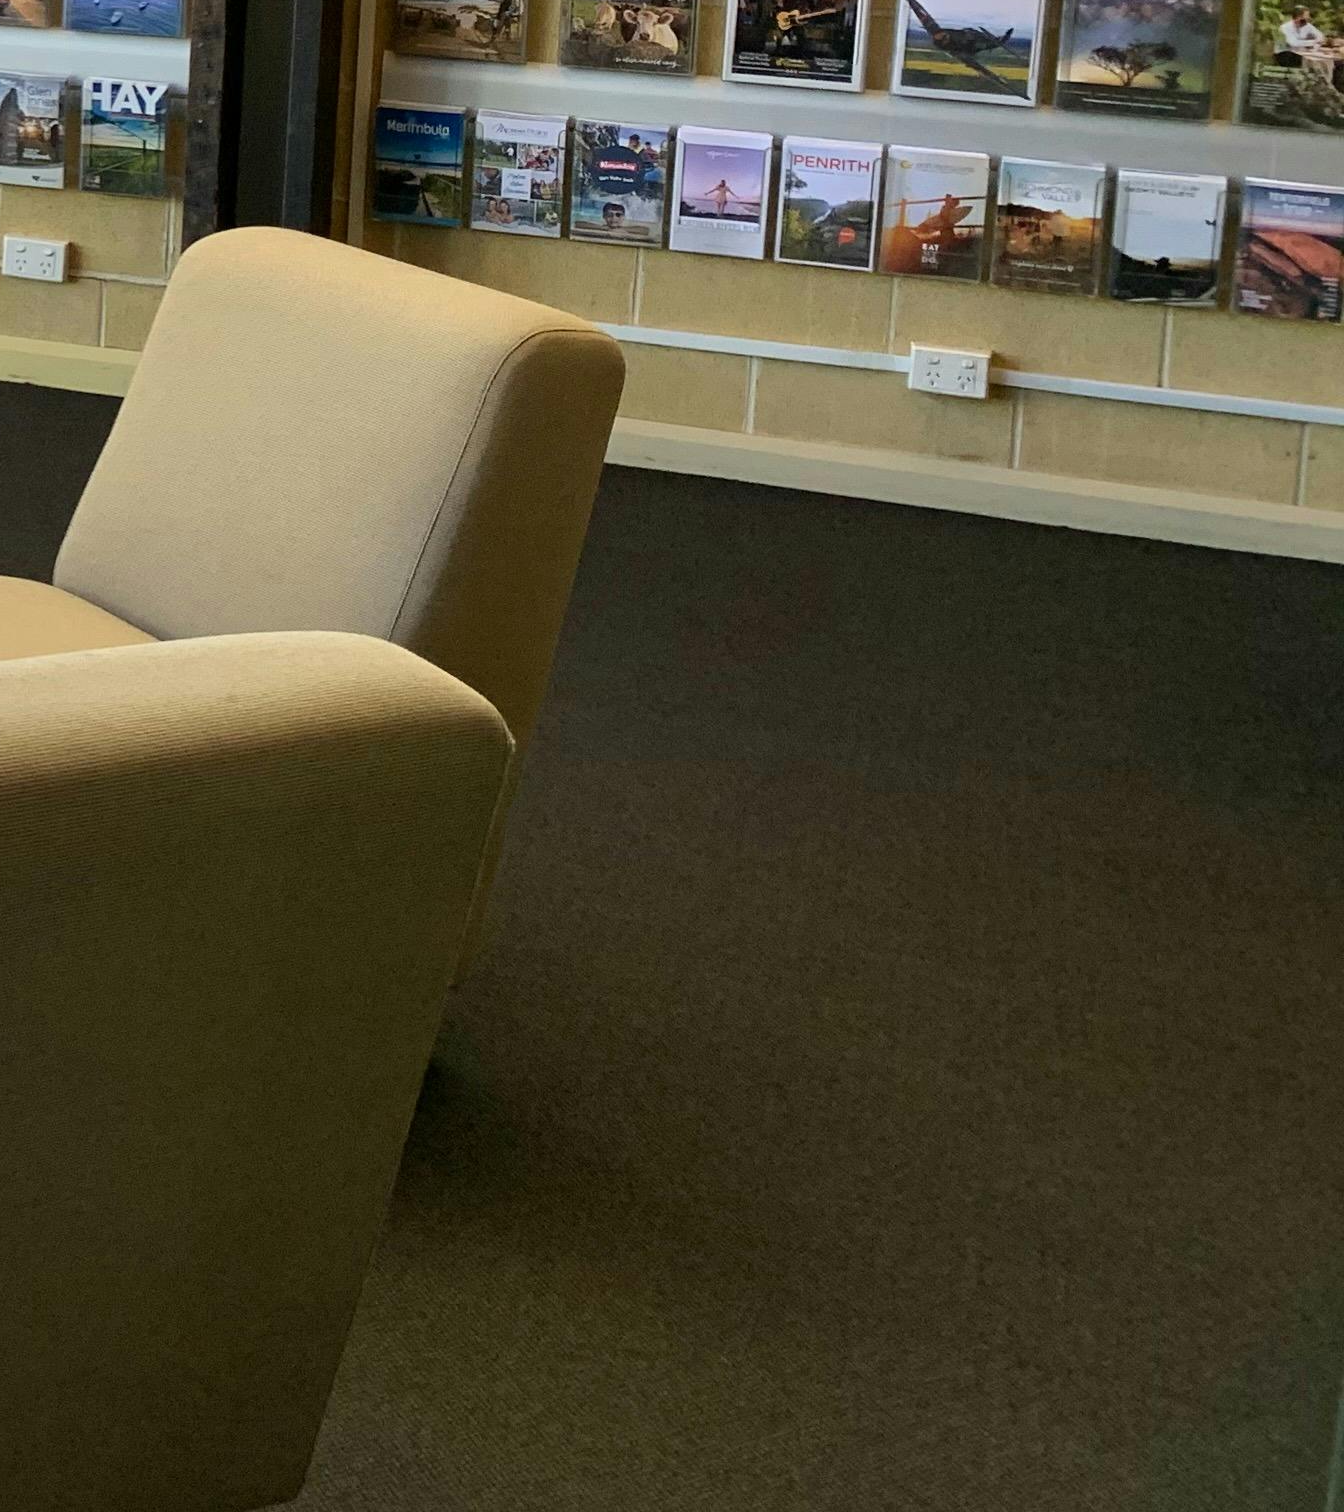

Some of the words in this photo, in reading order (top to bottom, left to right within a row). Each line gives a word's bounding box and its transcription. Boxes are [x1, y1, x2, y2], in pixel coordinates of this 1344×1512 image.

[83, 75, 170, 116] HAY
[386, 118, 450, 138] Merimbula
[793, 154, 870, 173] PENRITH
